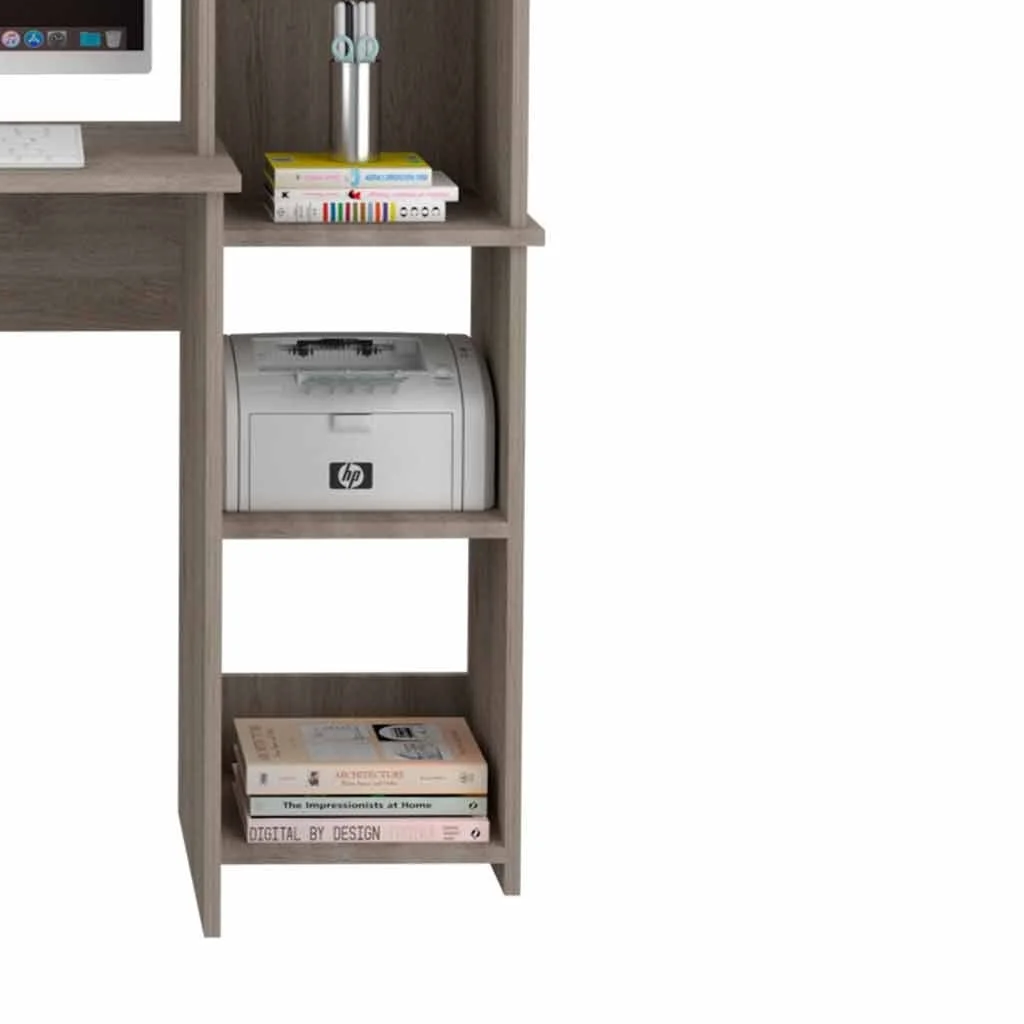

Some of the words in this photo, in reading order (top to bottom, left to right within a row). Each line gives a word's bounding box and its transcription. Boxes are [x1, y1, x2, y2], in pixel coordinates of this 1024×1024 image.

[283, 801, 302, 809] The
[305, 801, 383, 810] Impressionists
[401, 801, 432, 809] Home
[249, 826, 301, 841] DIGITAL
[309, 825, 325, 841] BY
[333, 825, 381, 841] DESIGN
